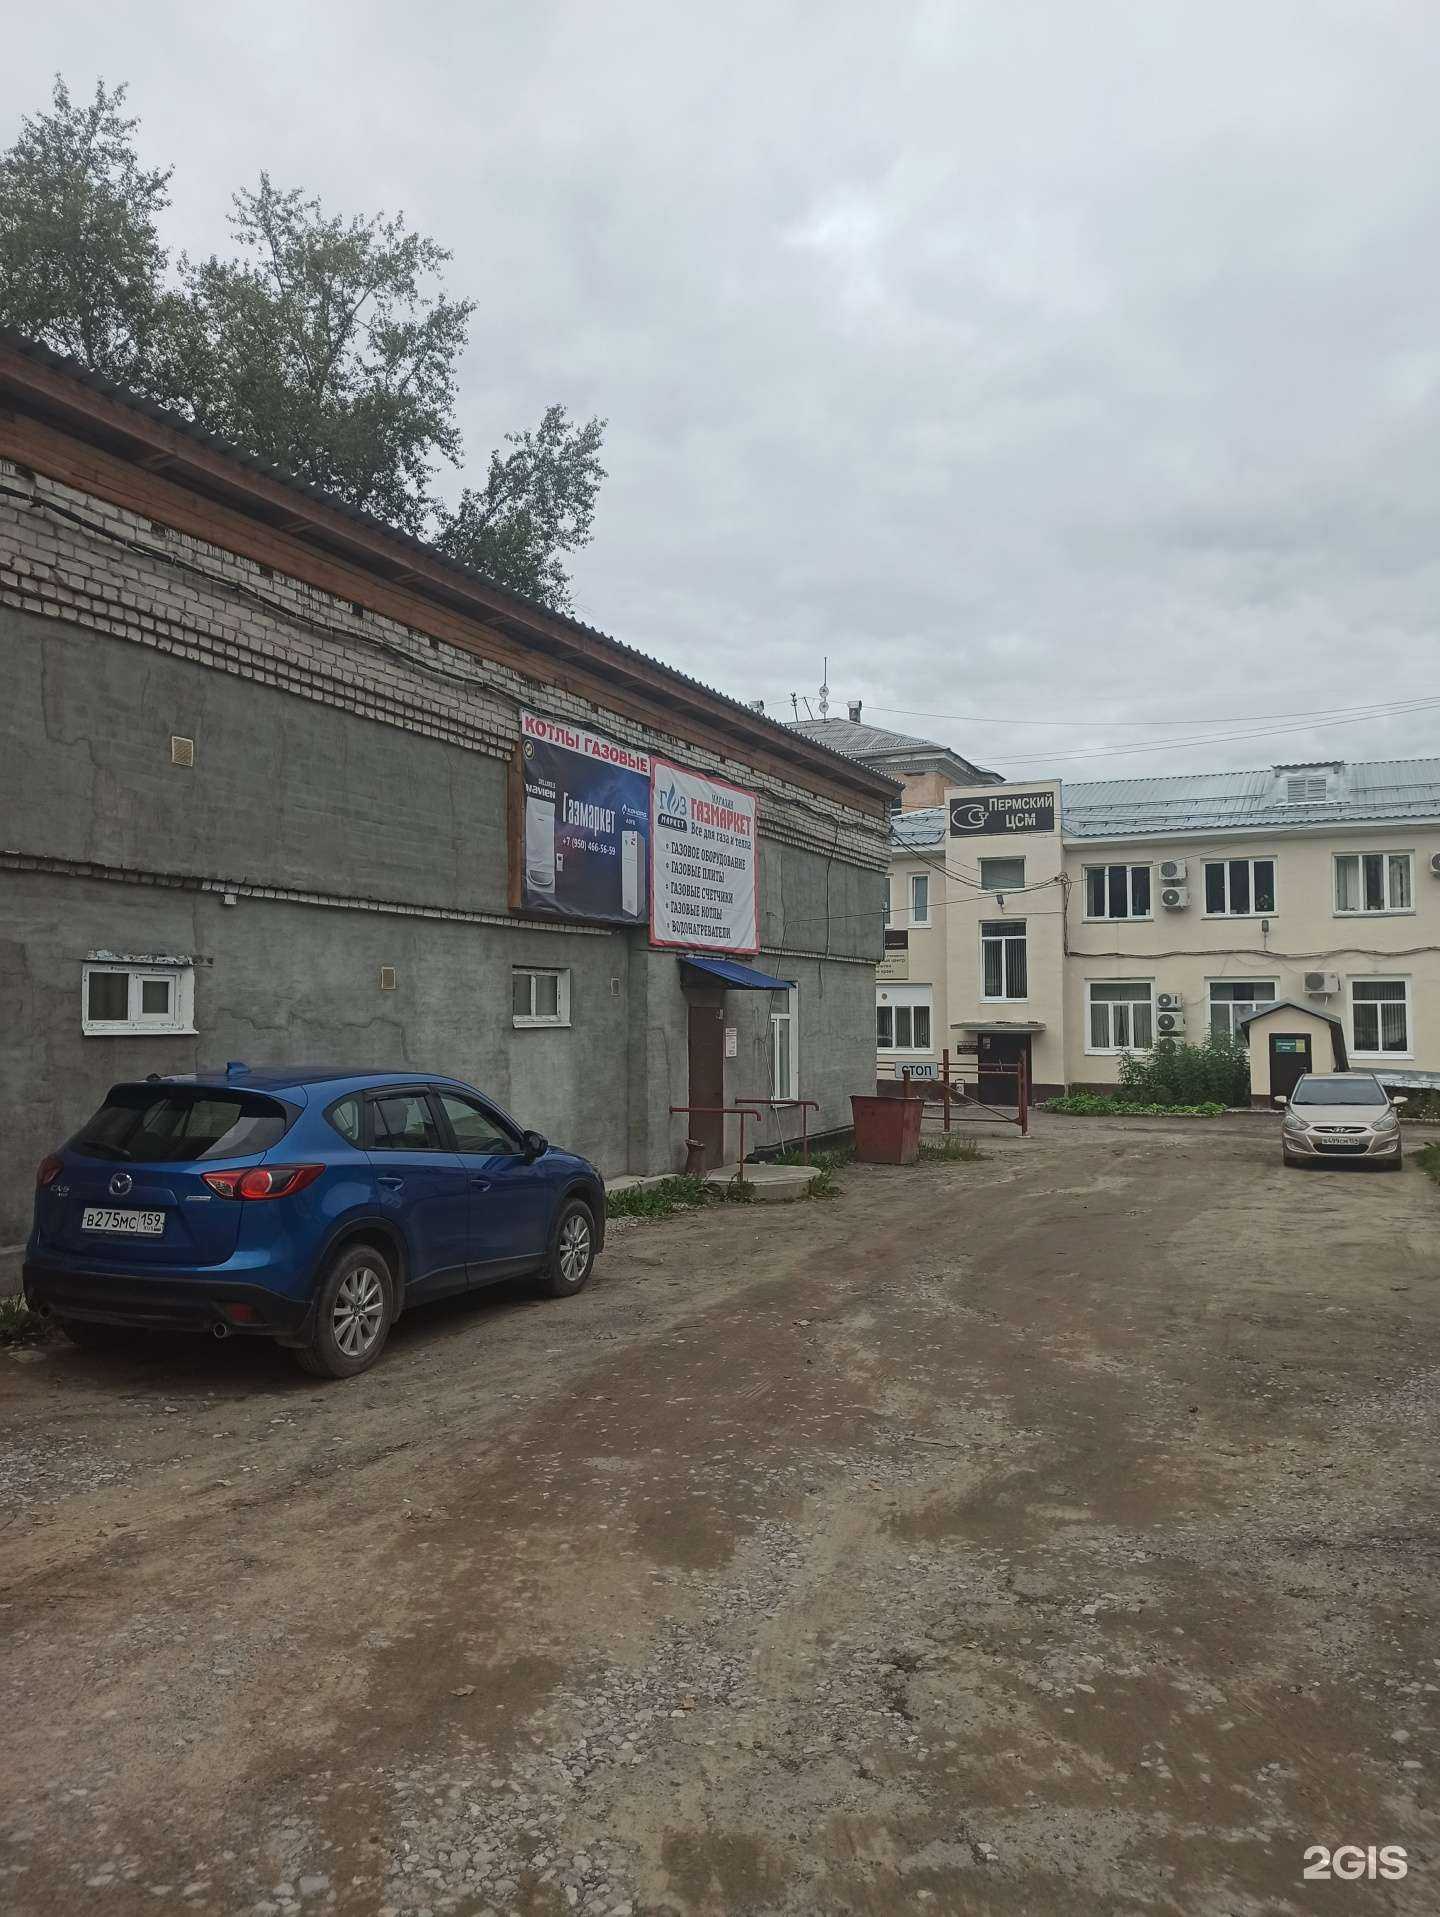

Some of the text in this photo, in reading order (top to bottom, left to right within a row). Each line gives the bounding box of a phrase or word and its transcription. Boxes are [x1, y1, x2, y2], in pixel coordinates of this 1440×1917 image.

[525, 716, 648, 772] КОТЛЫ ГАЗОВЫЕ
[989, 794, 1053, 811] ПЕРМСКИЙ
[562, 792, 616, 837] Газмаркет
[690, 798, 751, 836] ГАЗМАРКЕТ
[1005, 813, 1036, 830] ЦСМ
[691, 822, 703, 837] Все
[704, 829, 715, 841] для
[716, 832, 729, 844] газа
[563, 837, 570, 846] +7
[571, 838, 587, 852] (950)
[671, 842, 746, 870] ГАЗОВОЕ ОБОРУДОВАНИЕ
[671, 861, 725, 883] ГАЗОВЫЕ ПЛИТЫ
[671, 882, 734, 904] ГАЗОВЫЕ СЧЕТЧИКИ
[671, 901, 722, 920] ГАЗОВЫЕ КОТЛЫ
[672, 920, 731, 939] ВОДОНАГРЕВАТЕЛИ
[902, 1065, 932, 1076] СТОП
[86, 1211, 161, 1229] В275МС 159
